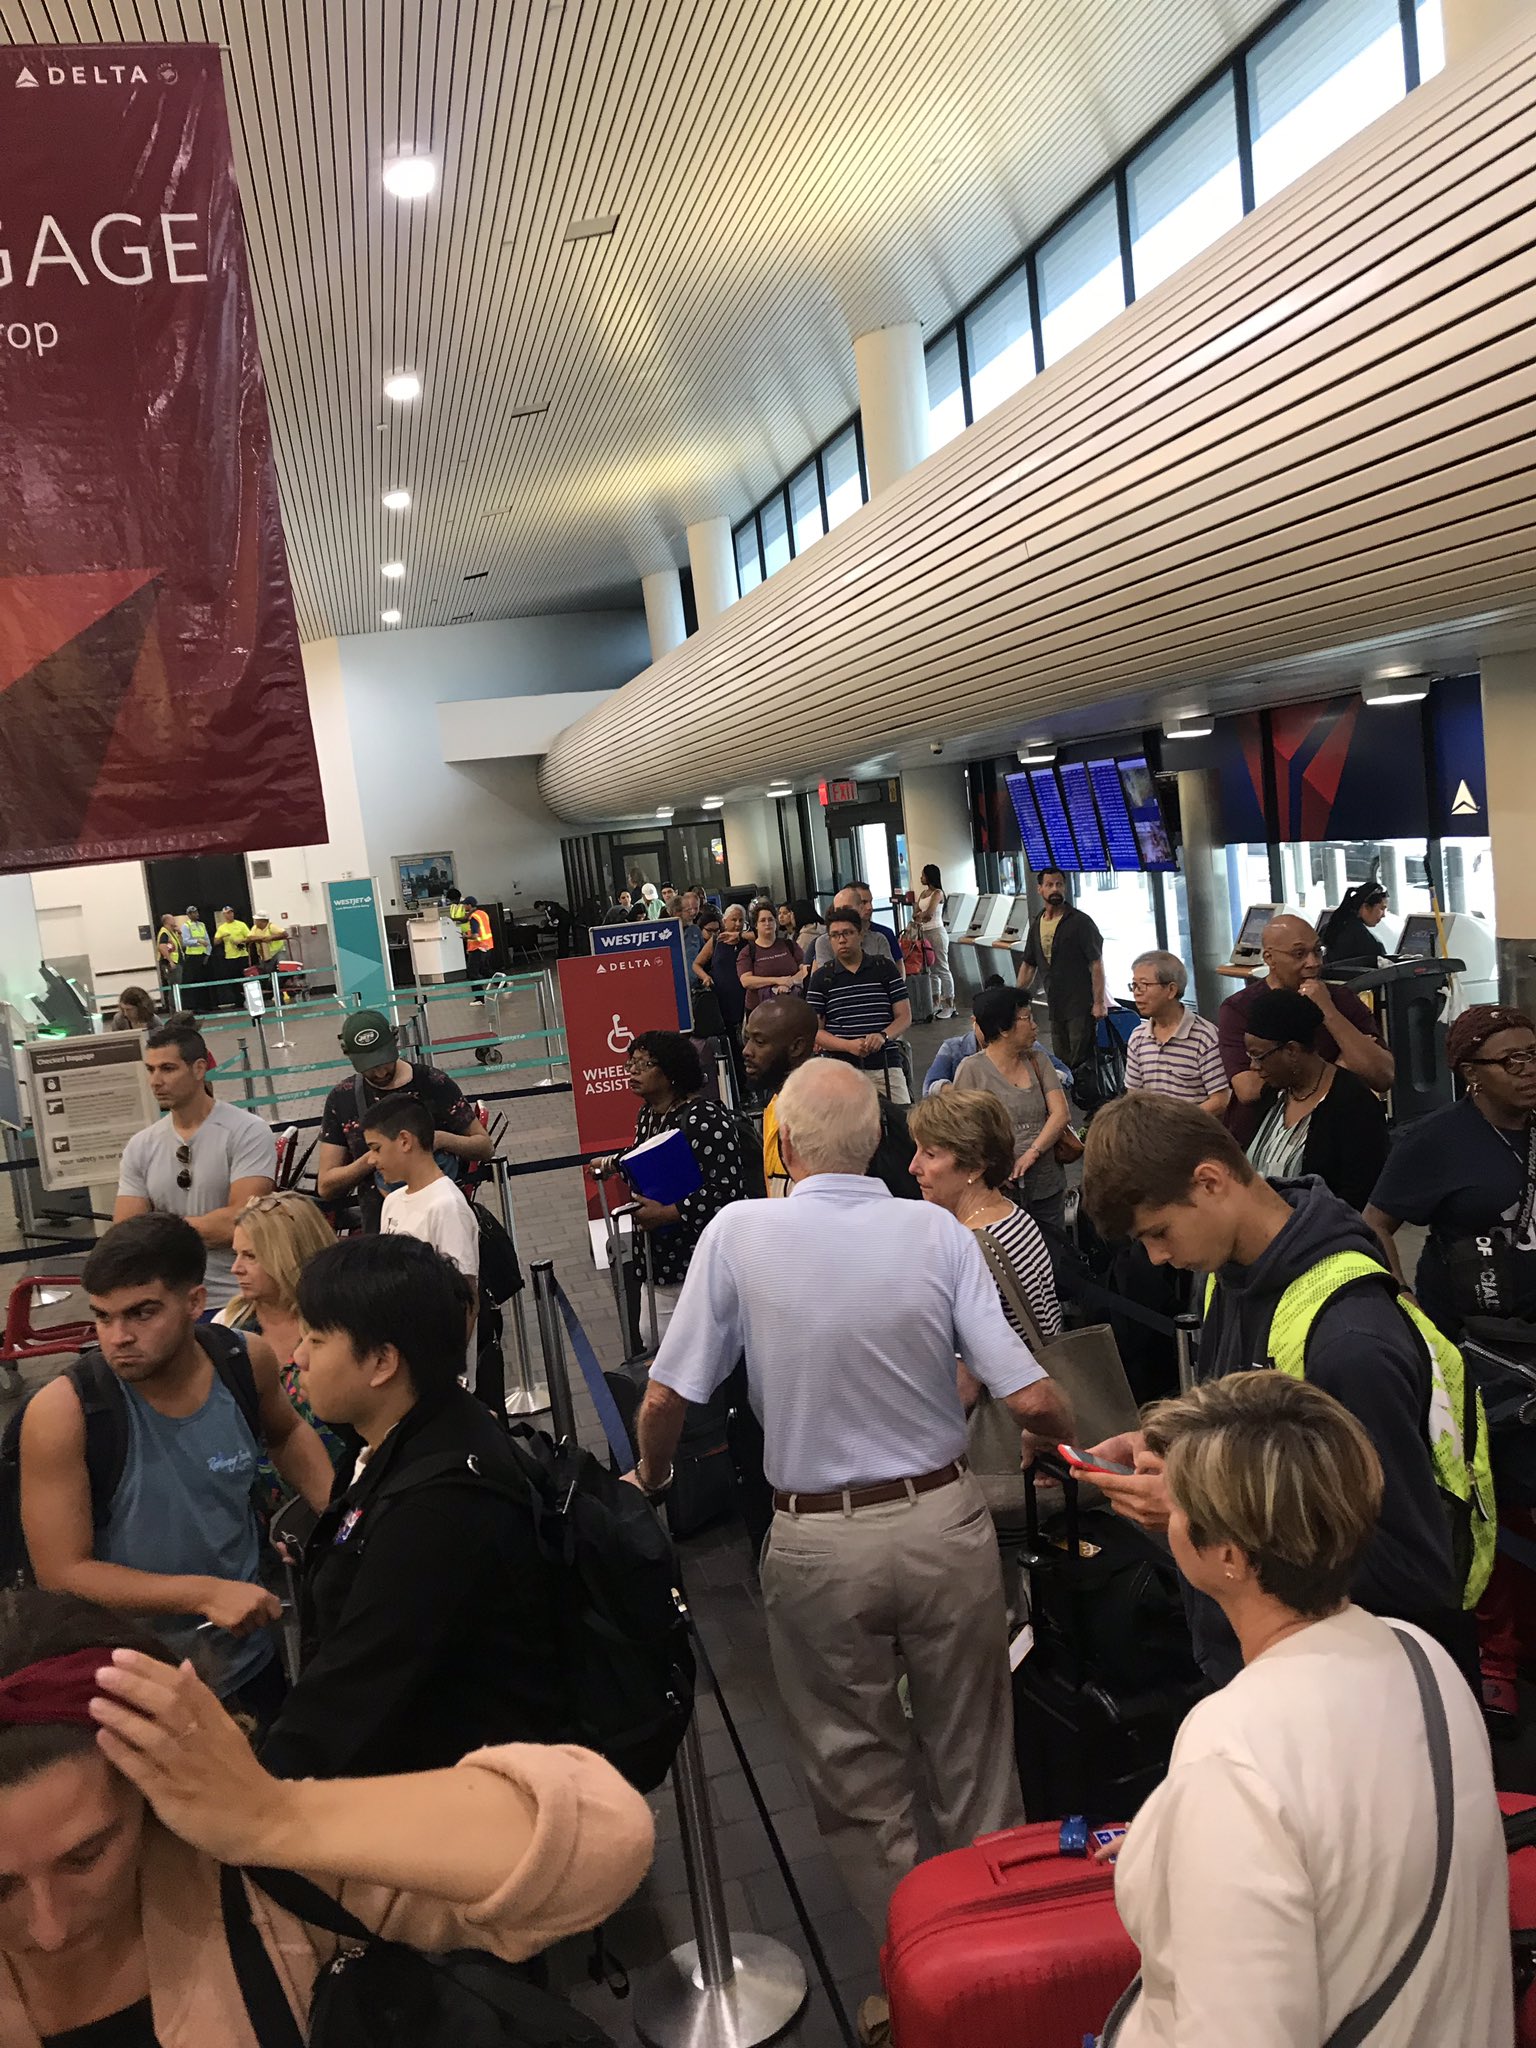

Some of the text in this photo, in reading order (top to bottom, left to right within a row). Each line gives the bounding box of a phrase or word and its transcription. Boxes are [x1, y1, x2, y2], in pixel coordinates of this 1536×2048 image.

[47, 65, 148, 85] DELTA
[831, 782, 856, 801] EXIT
[333, 897, 364, 906] WESTJET
[601, 930, 659, 947] WESTJET
[609, 958, 651, 972] DELTA
[585, 1078, 633, 1095] ASSIST
[1519, 1182, 1535, 1229] OFFICIA
